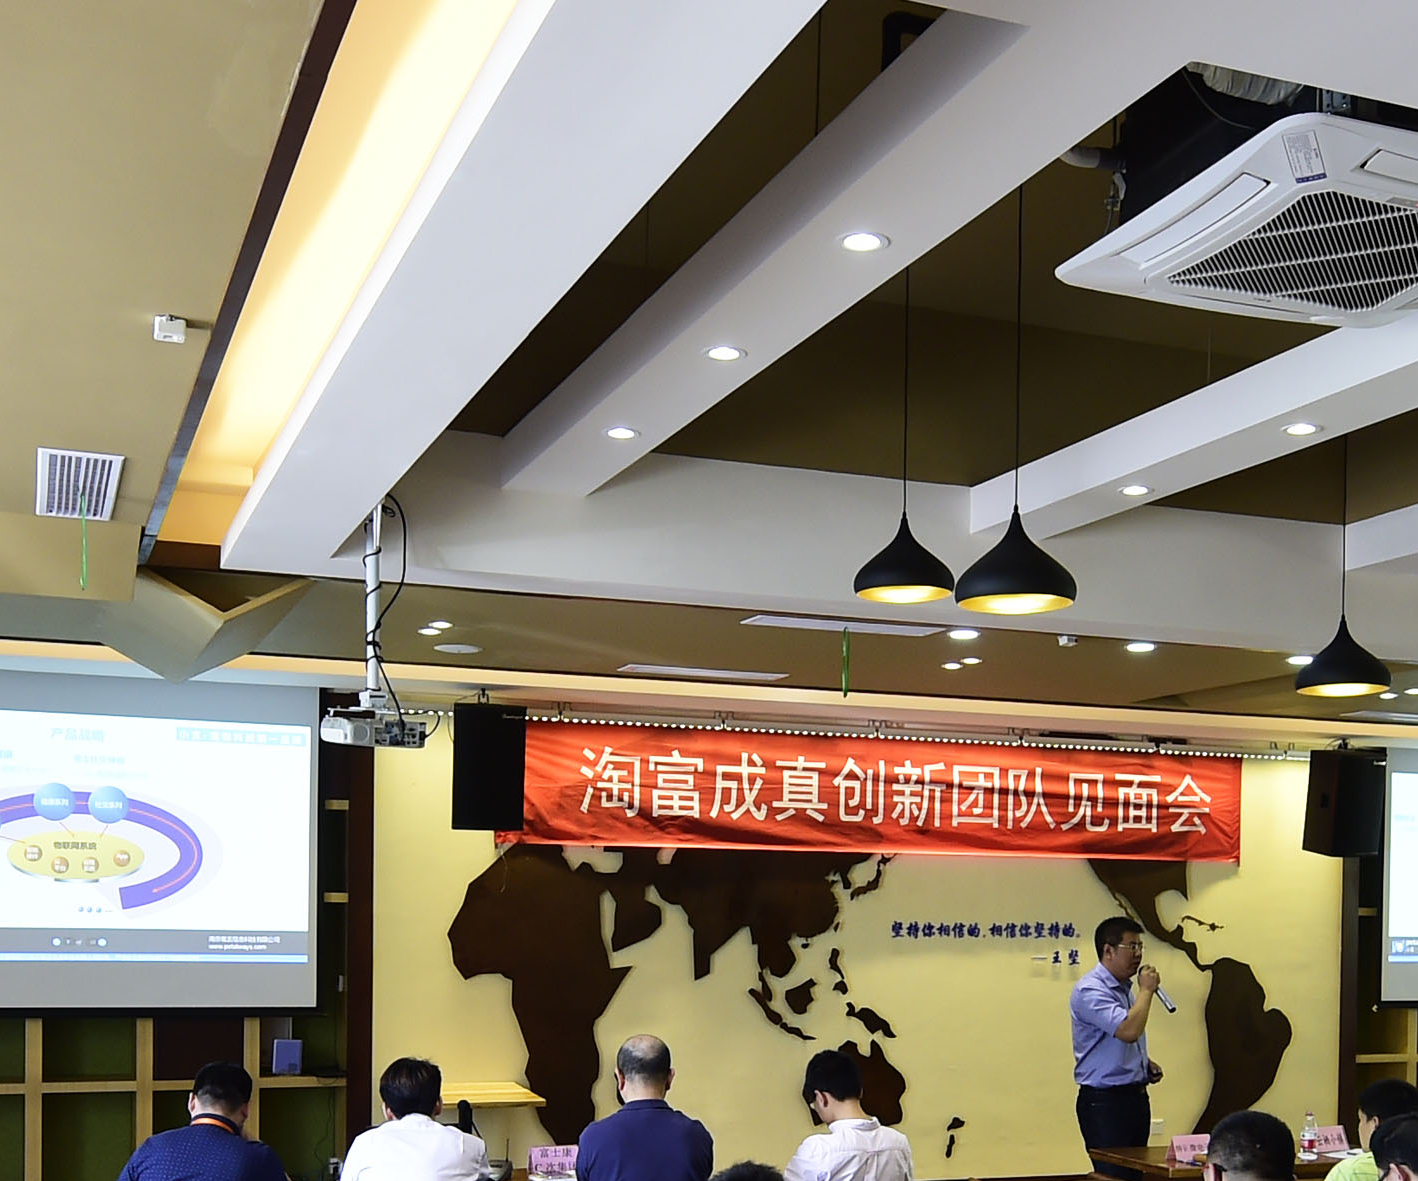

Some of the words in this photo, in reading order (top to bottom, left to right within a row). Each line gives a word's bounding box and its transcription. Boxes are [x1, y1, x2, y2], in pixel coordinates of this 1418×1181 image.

[579, 745, 1214, 836] 淘富成真创新团队见面会
